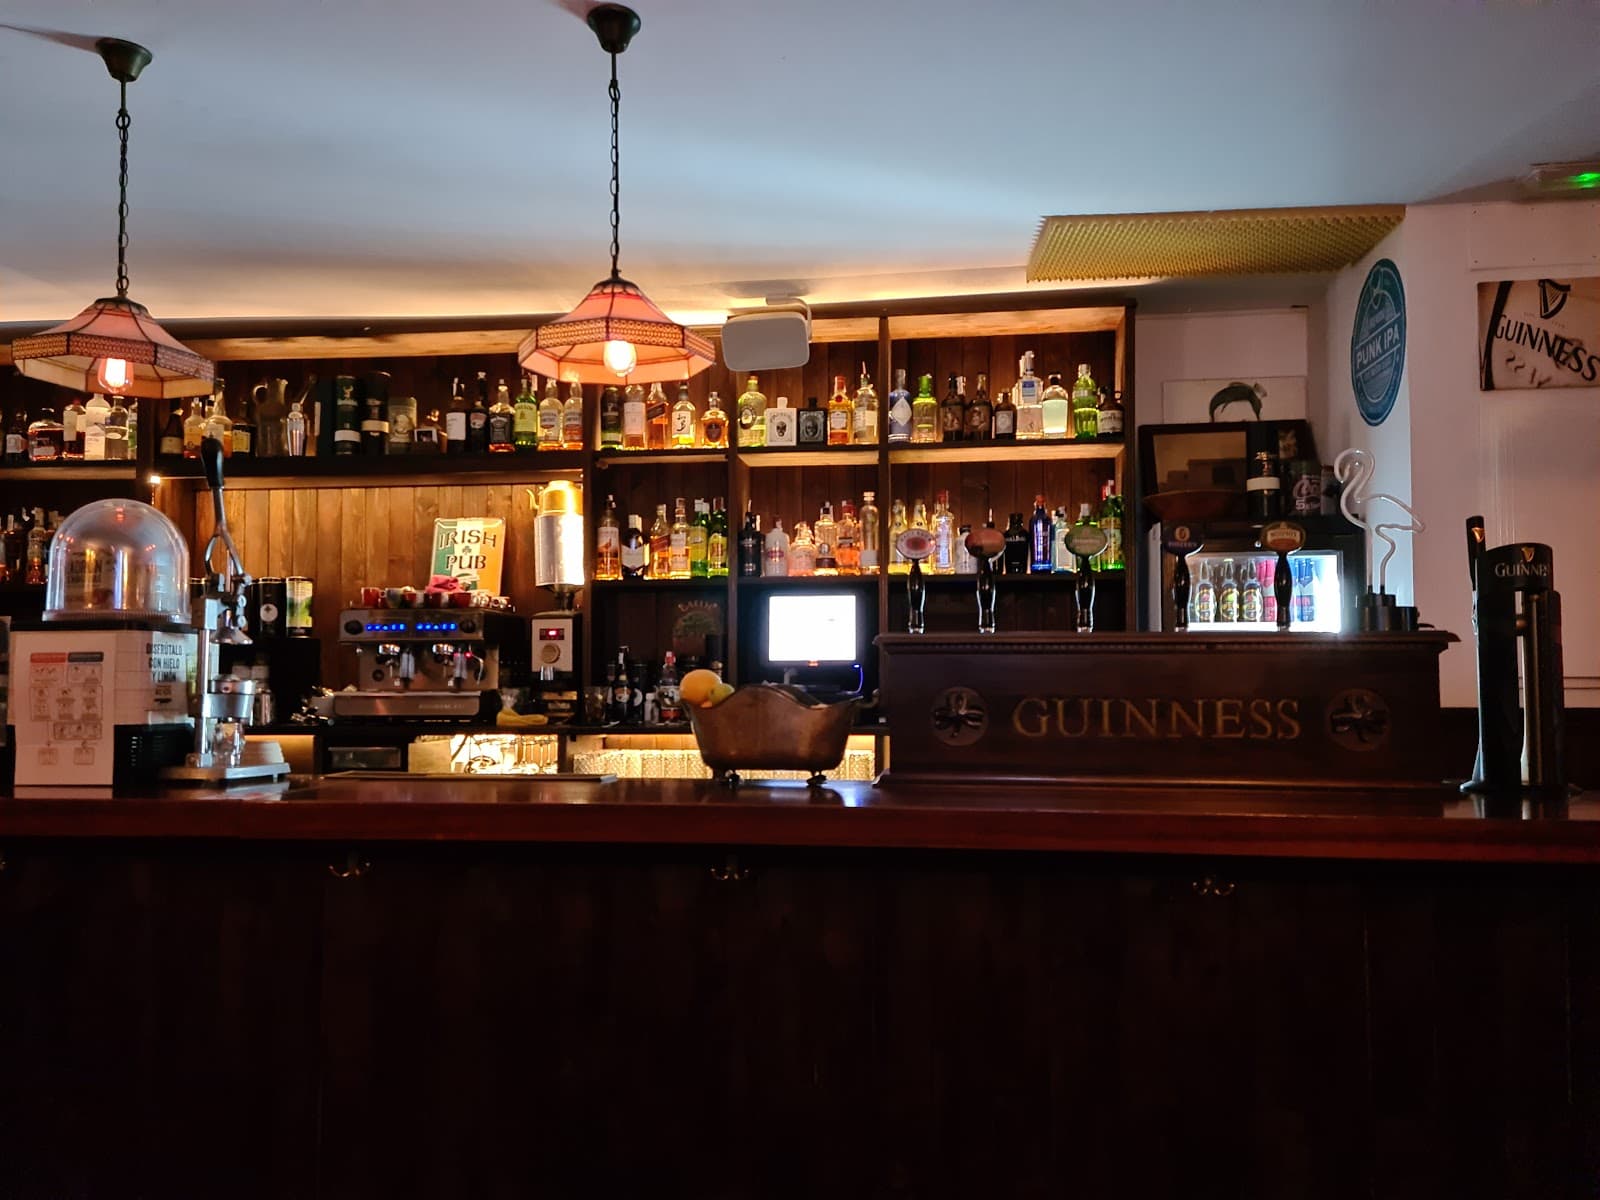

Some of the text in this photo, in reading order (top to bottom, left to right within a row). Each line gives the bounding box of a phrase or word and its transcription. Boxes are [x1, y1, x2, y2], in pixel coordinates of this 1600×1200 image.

[1356, 335, 1382, 369] PUNK
[1384, 323, 1400, 350] IPA
[1495, 314, 1600, 382] GUINNESS
[439, 529, 497, 549] IRISH
[446, 554, 487, 570] PUB
[163, 658, 180, 669] HIELO
[1012, 697, 1303, 740] GUINNESS
